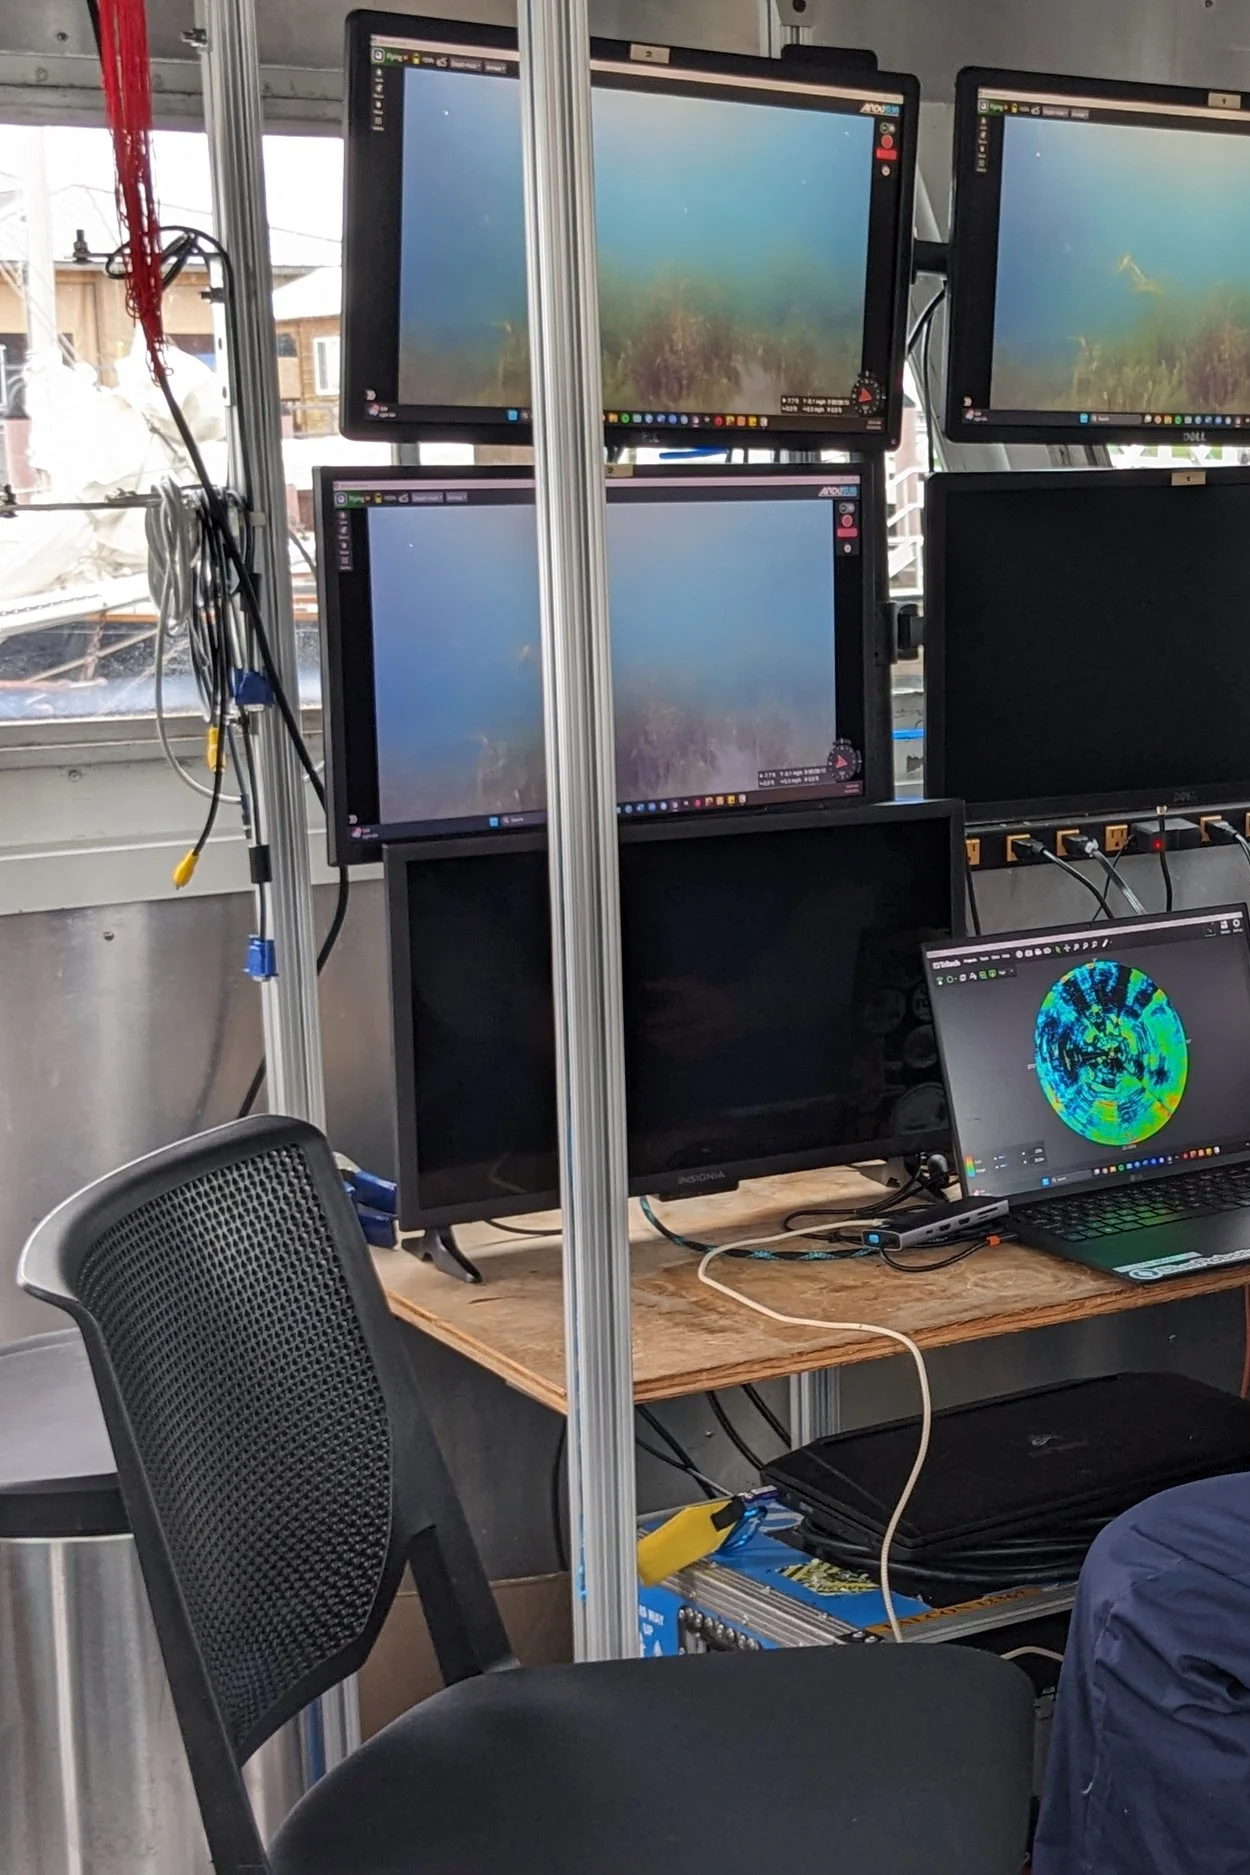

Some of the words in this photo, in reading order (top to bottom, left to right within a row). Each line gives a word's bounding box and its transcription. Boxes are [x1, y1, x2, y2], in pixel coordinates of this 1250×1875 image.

[645, 50, 653, 58] 2
[677, 1170, 726, 1185] INSIGNIA
[648, 1608, 665, 1627] WAY
[642, 1622, 654, 1636] UP
